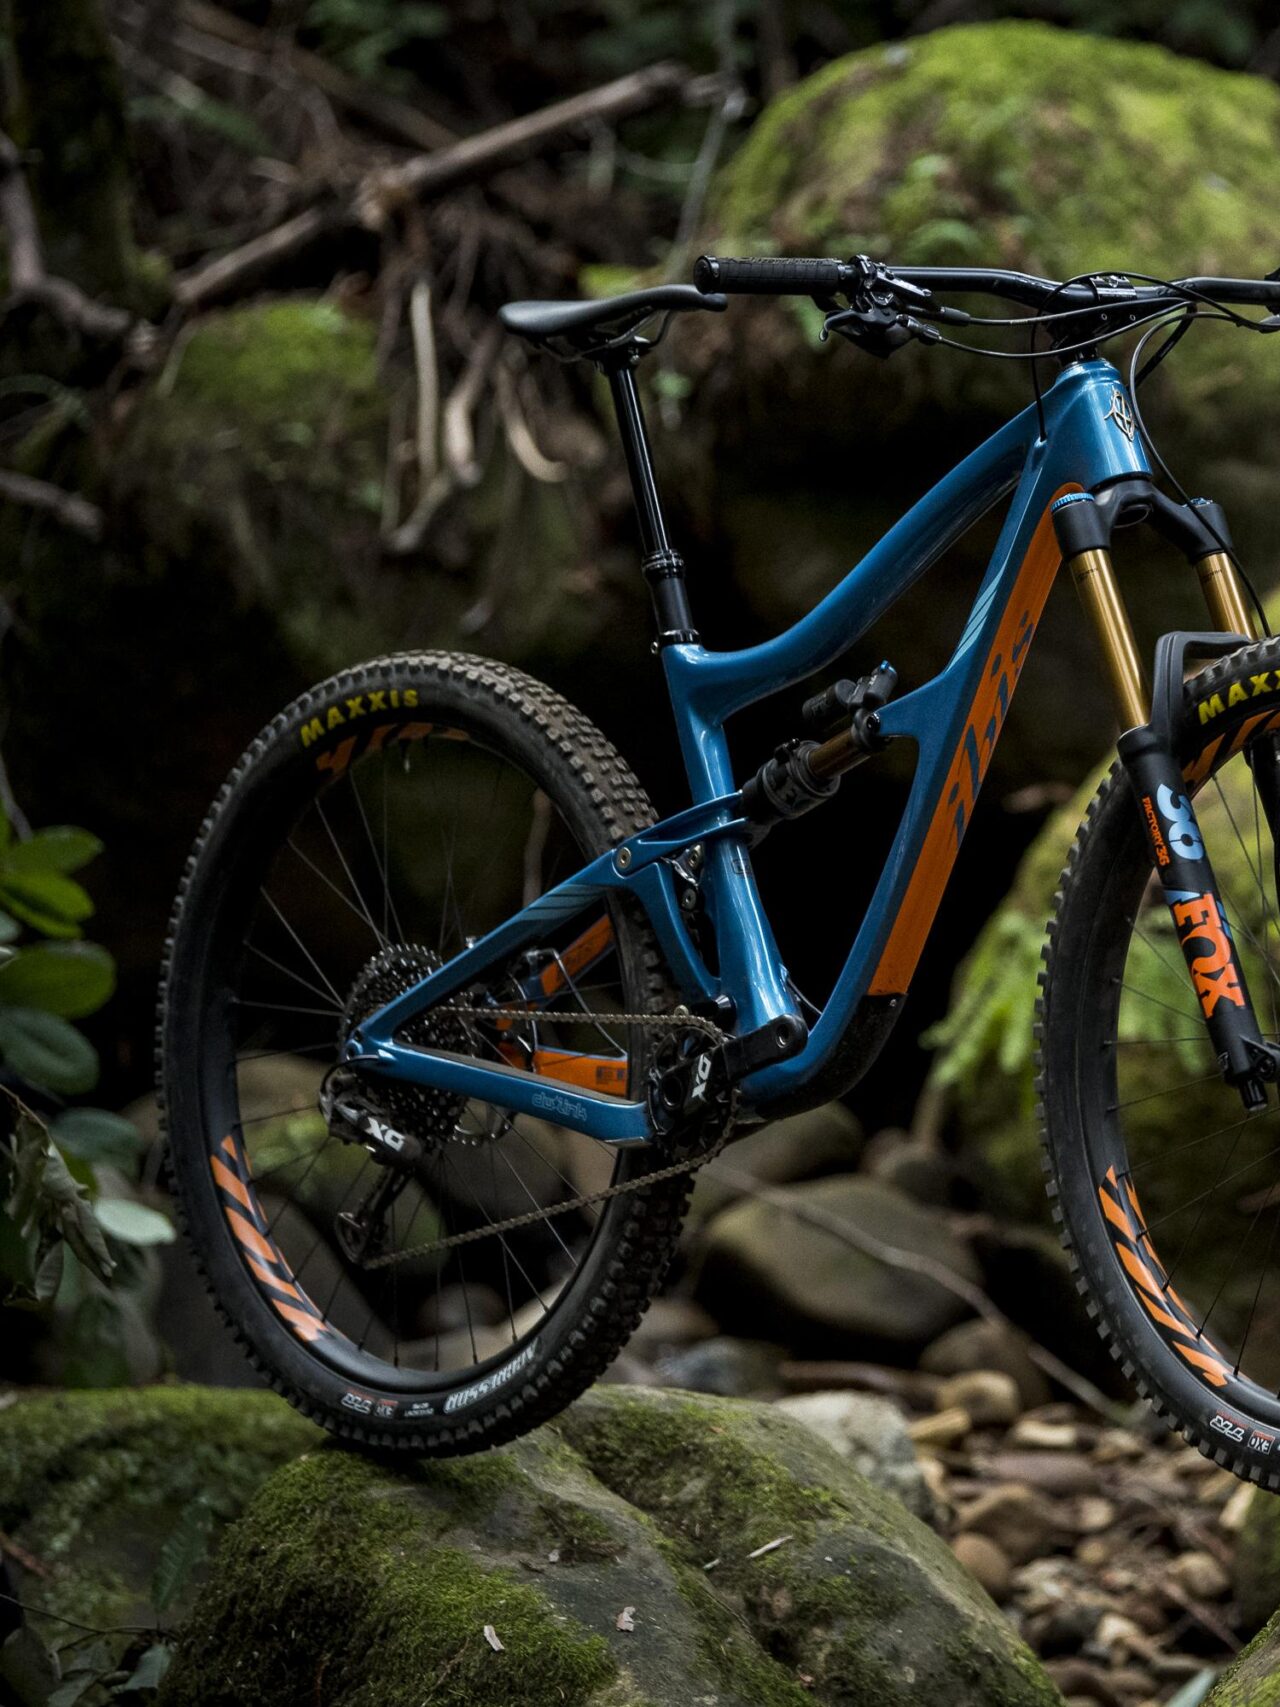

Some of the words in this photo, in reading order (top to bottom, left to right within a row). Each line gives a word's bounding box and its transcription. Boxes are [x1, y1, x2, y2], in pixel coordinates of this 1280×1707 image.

[301, 689, 420, 748] MAXXIS
[1142, 797, 1164, 848] FACTORY
[1172, 893, 1245, 1019] FOX
[1210, 1414, 1245, 1442] TR
[1248, 1437, 1271, 1454] EXO
